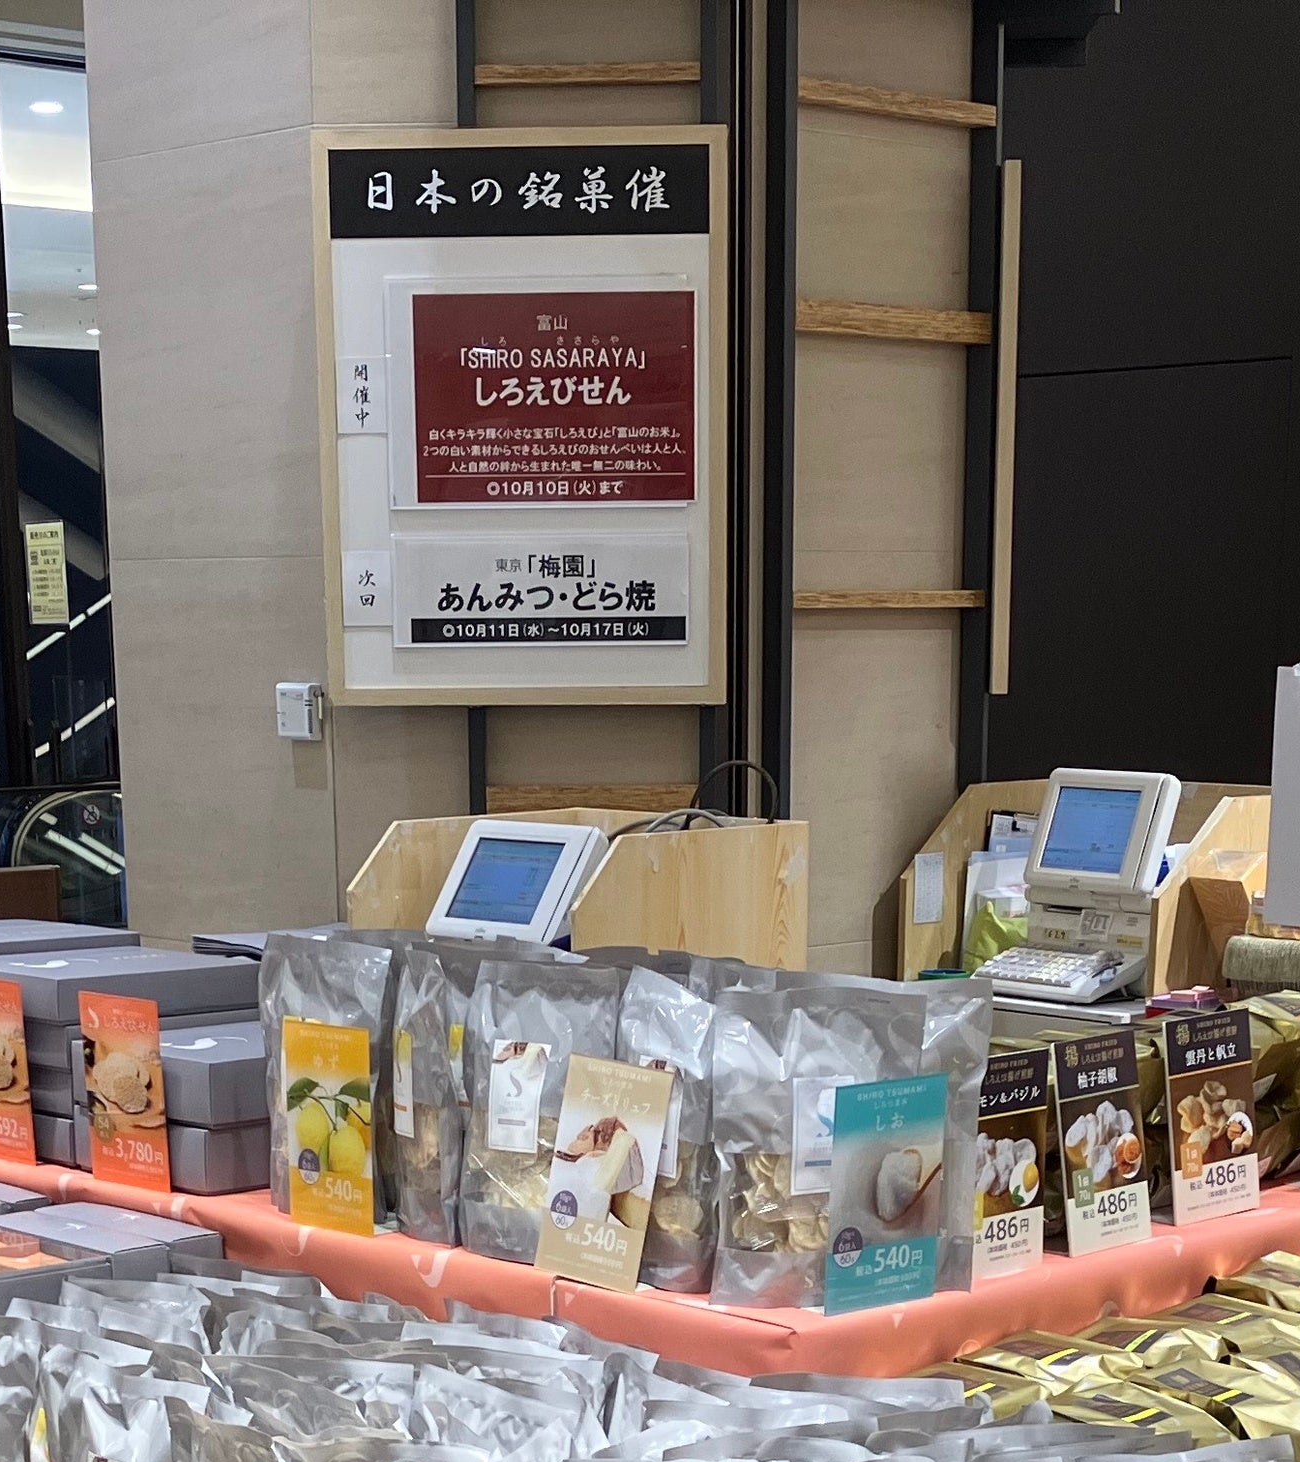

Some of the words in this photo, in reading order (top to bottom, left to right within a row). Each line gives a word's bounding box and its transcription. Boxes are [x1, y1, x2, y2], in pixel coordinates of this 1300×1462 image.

[366, 165, 672, 214] 日本の銘菓催
[536, 314, 569, 332] 富山
[352, 363, 372, 428] 開催中
[475, 375, 632, 407] しろえびせん
[494, 557, 523, 574] 東京
[357, 568, 377, 609] 次回
[437, 580, 657, 613] あんみつ・どら焼
[312, 1054, 340, 1071] ゆず
[1184, 1042, 1238, 1067] 雲丹と帆立
[1077, 1066, 1119, 1090] 柚子胡椒
[875, 1112, 905, 1132] しお
